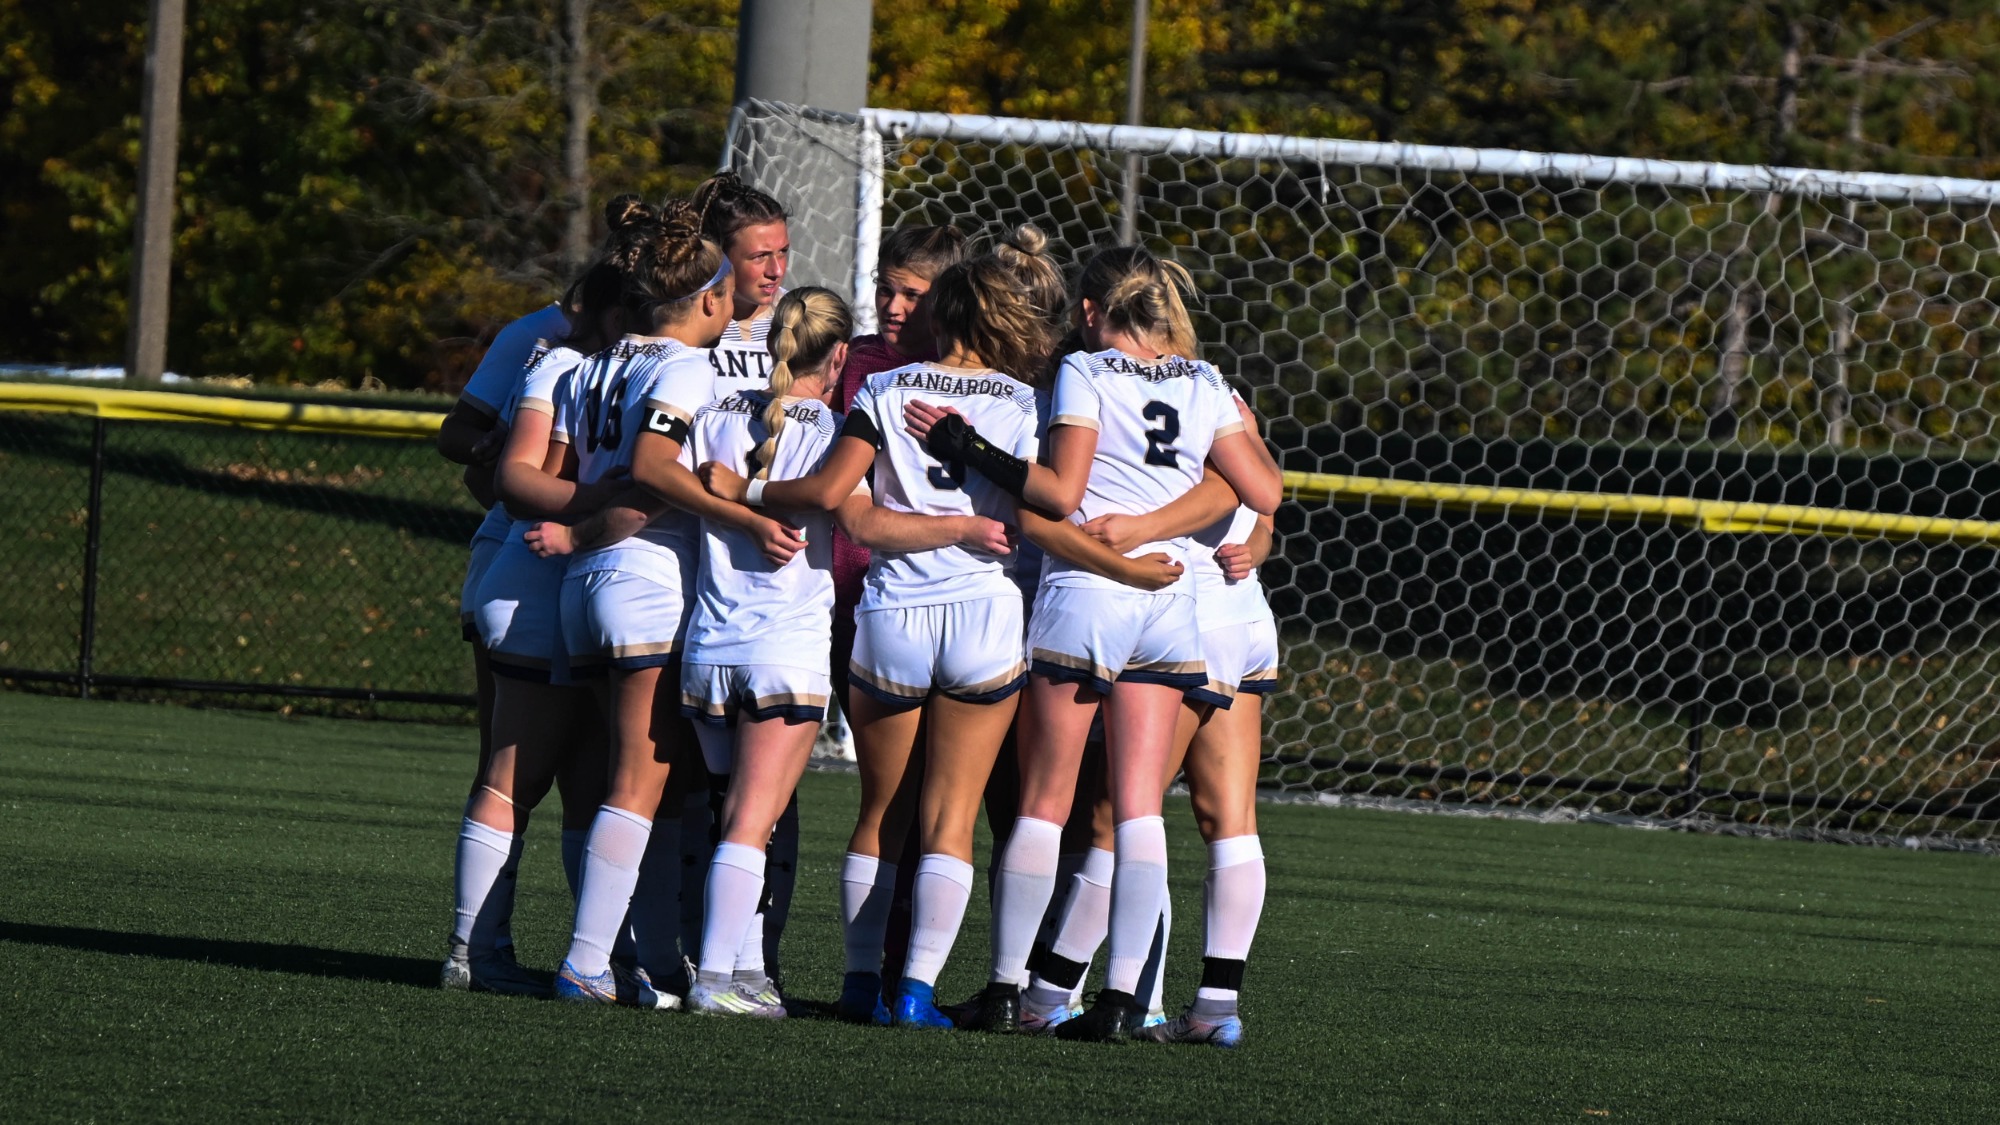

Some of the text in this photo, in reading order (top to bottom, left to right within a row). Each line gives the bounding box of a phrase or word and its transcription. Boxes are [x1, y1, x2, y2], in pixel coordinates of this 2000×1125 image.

[895, 372, 1014, 397] KANGAROOS
[648, 408, 677, 433] C
[718, 396, 821, 425] KANOOS
[1142, 398, 1181, 469] 2
